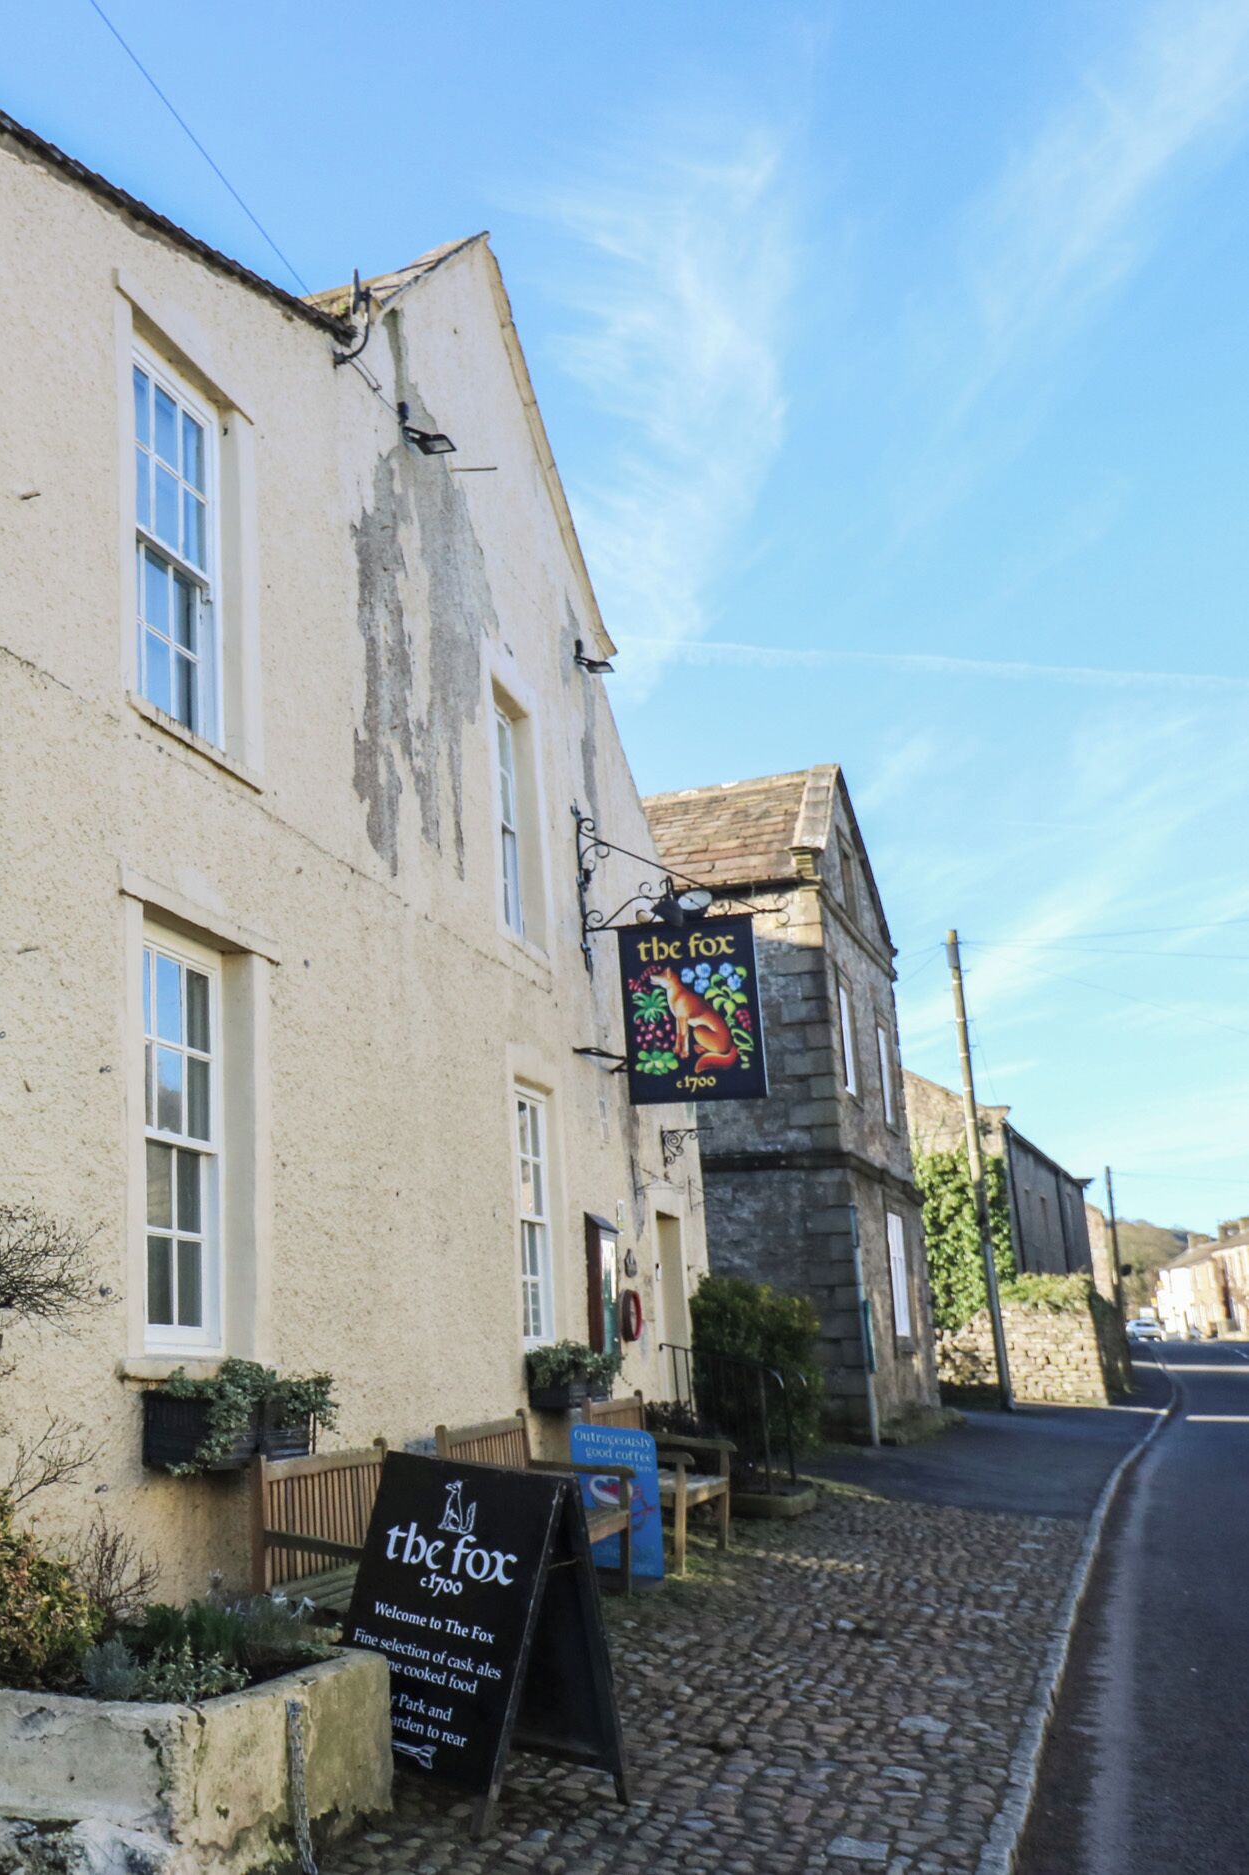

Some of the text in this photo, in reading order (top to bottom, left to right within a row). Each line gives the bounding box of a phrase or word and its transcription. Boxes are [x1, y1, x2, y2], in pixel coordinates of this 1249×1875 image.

[636, 932, 736, 962] the fox
[574, 1429, 651, 1449] Outrageously
[585, 1446, 653, 1463] good coffee
[386, 1522, 518, 1586] the fox
[374, 1601, 496, 1645] Welcome to The Fox
[353, 1628, 502, 1680] Fine selection of cask ales
[403, 1665, 447, 1686] cooked
[448, 1674, 478, 1695] food
[399, 1693, 426, 1715] Park
[428, 1705, 453, 1722] and
[392, 1716, 468, 1748] arden to rear
